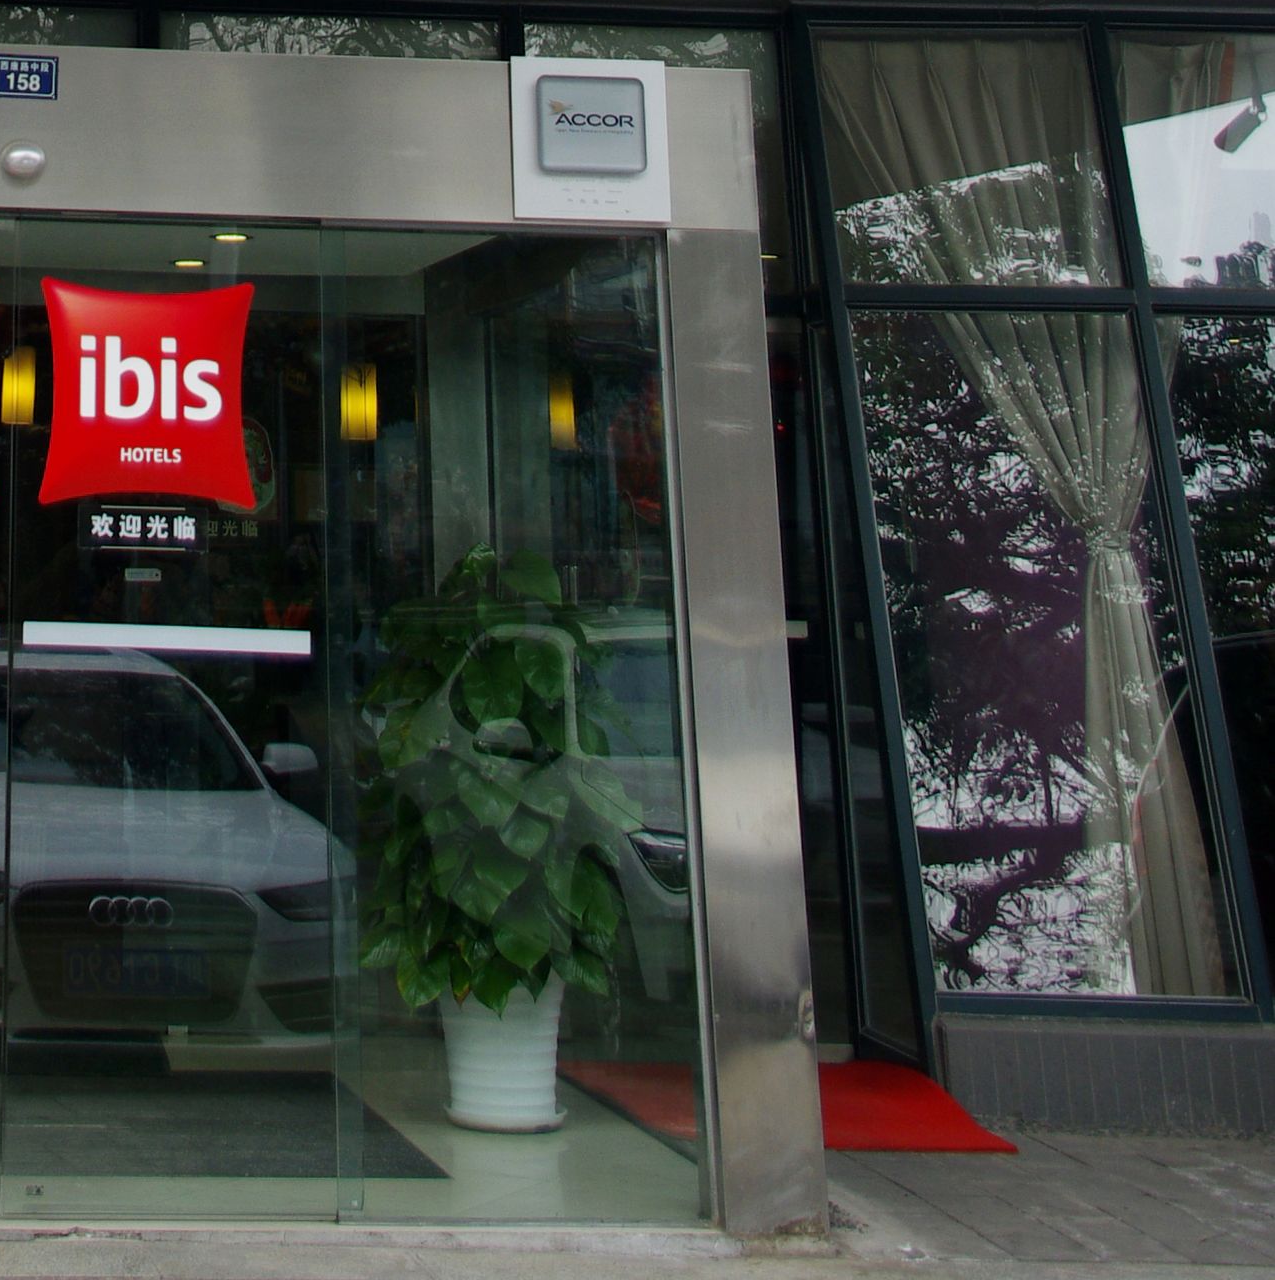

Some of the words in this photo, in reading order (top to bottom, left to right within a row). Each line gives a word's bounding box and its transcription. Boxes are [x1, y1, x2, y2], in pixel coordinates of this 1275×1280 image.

[6, 72, 41, 92] 158
[555, 113, 635, 128] ACCOR
[79, 335, 223, 422] ibis
[120, 447, 182, 464] HOTELS
[91, 513, 197, 540] 欢迎光临
